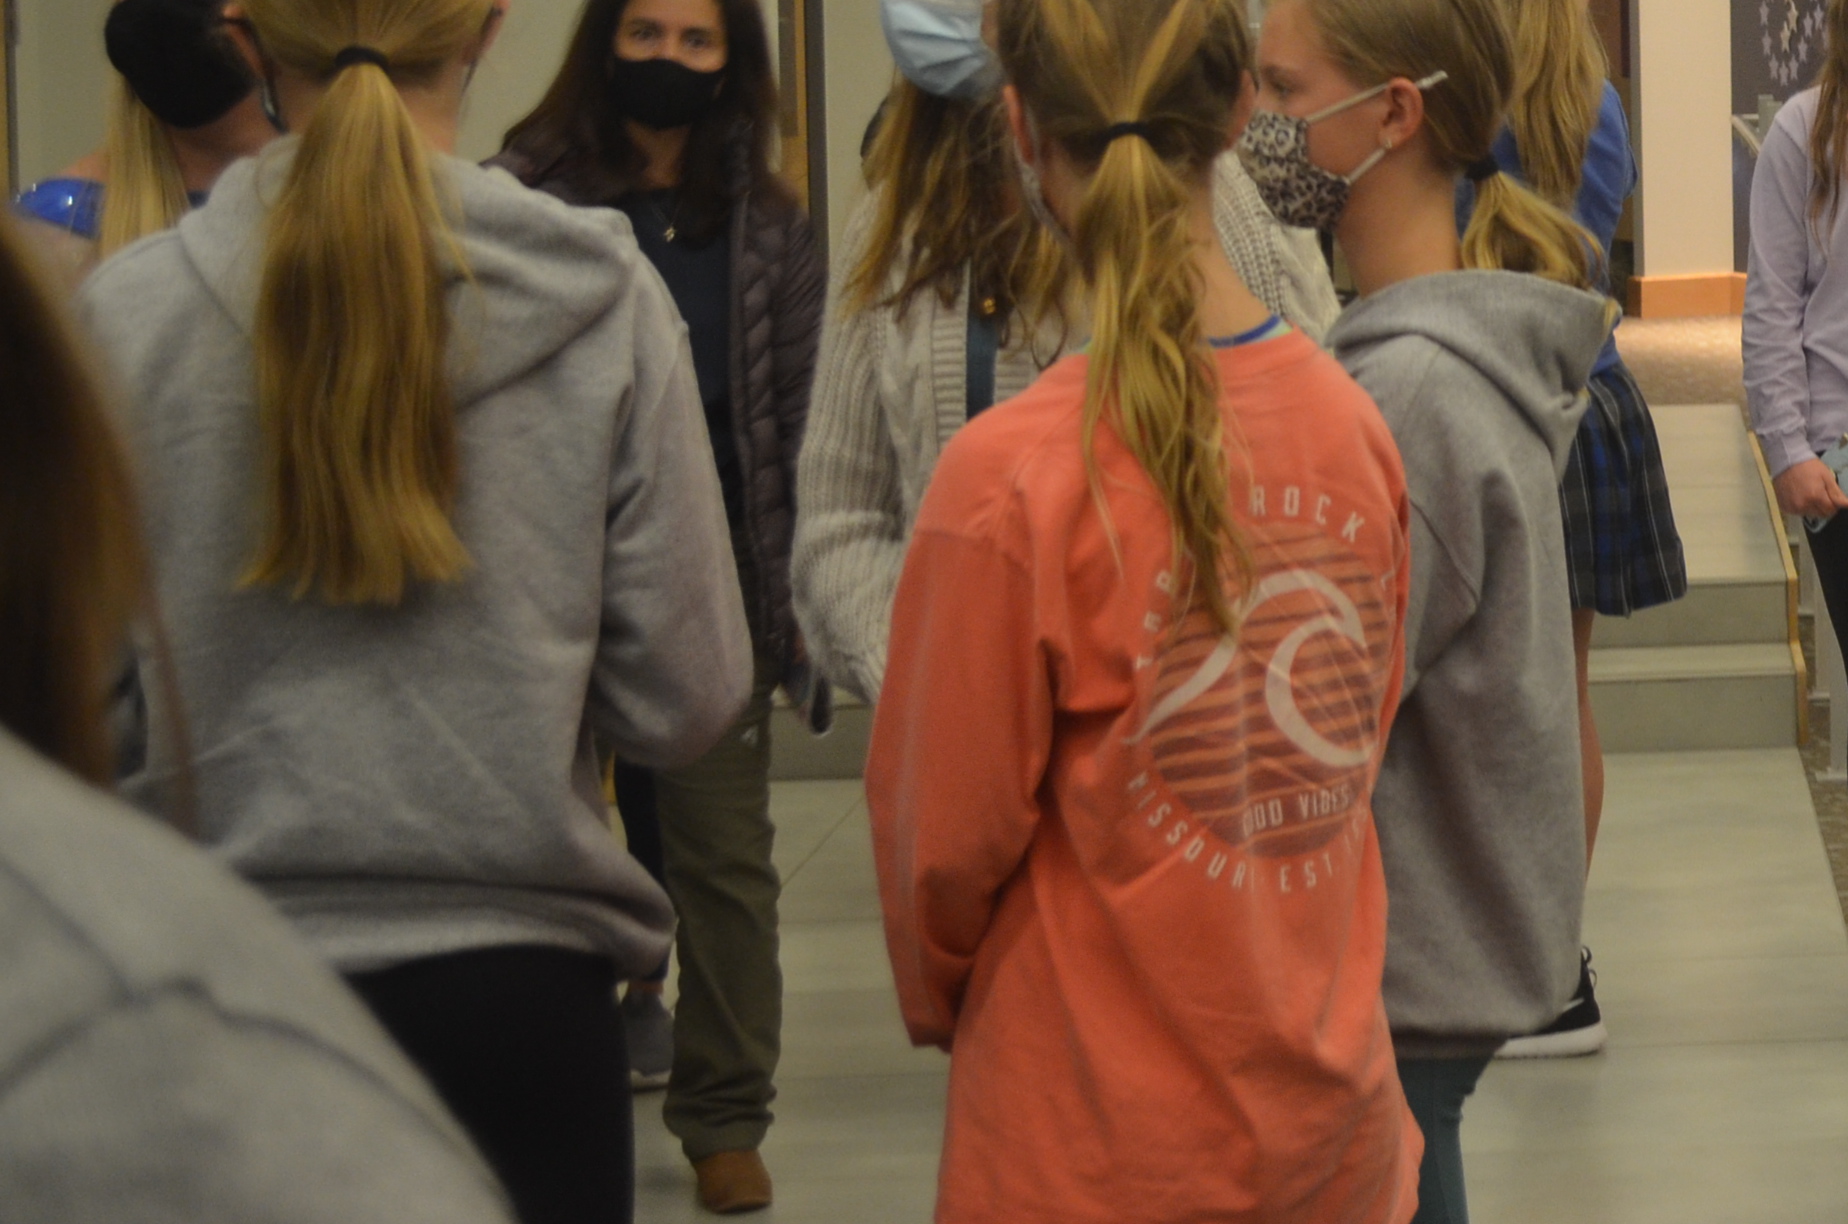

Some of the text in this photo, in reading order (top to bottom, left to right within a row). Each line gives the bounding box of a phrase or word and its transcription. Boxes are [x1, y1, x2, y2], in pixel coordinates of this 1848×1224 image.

[1250, 484, 1366, 544] ROCK
[1299, 782, 1350, 821] VIBES
[1279, 854, 1334, 894] EST
